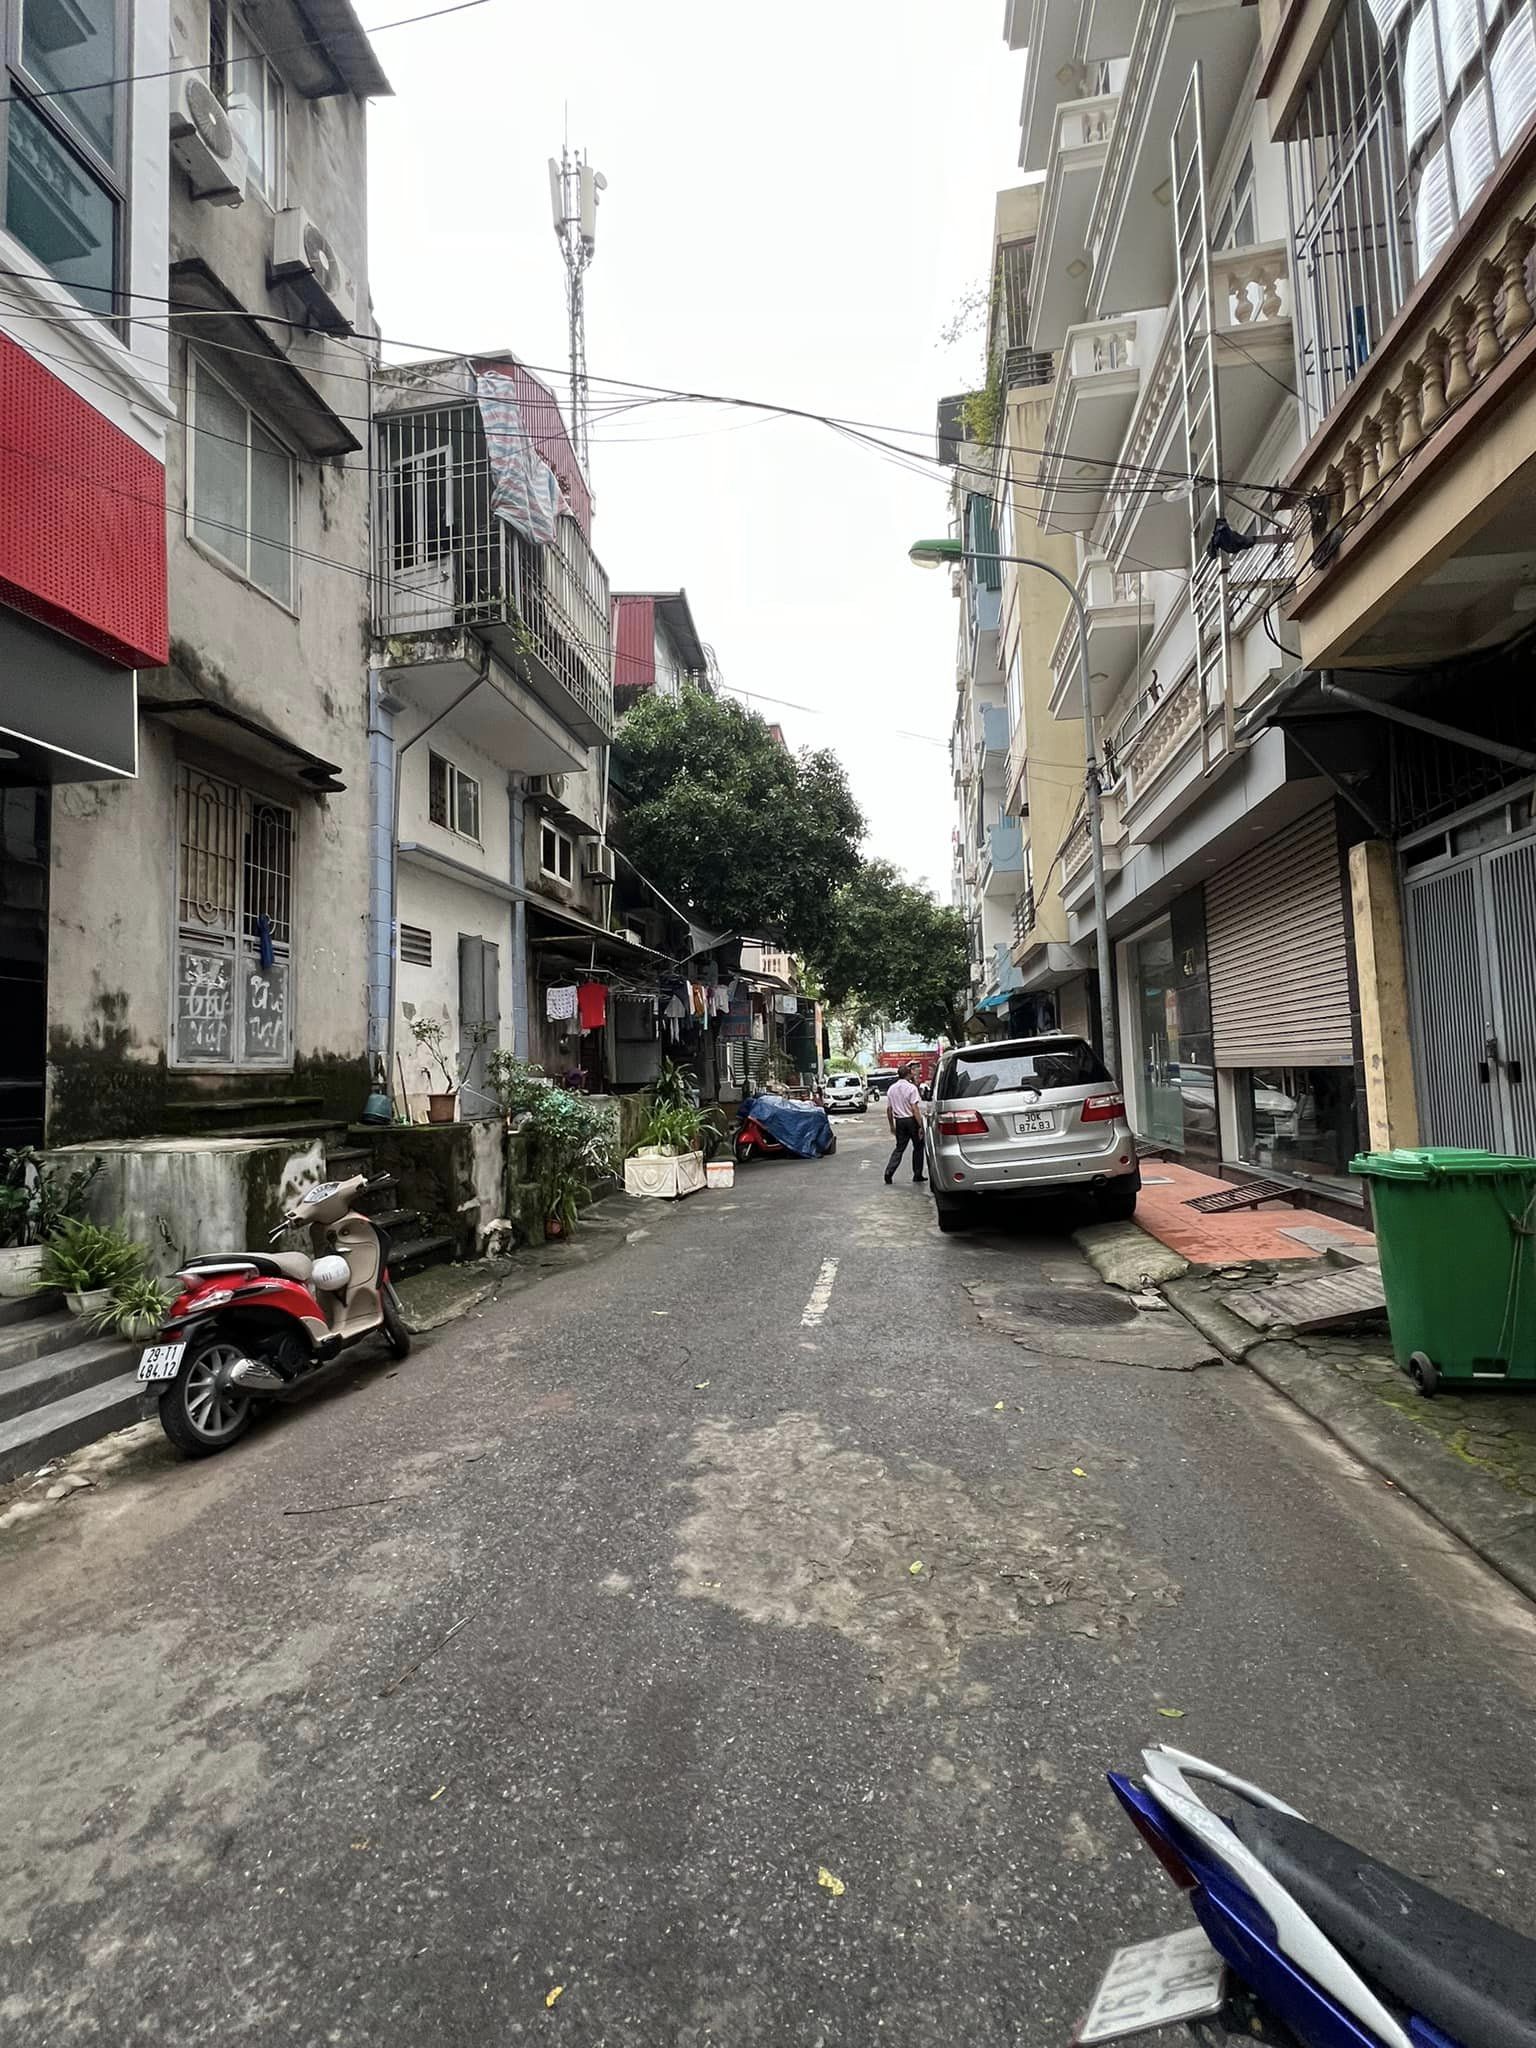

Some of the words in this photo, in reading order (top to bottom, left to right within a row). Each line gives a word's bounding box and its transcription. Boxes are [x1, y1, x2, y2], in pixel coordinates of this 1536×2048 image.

[1025, 1113, 1041, 1122] 30K
[147, 1346, 177, 1362] 29-T1
[140, 1362, 176, 1379] 484.12
